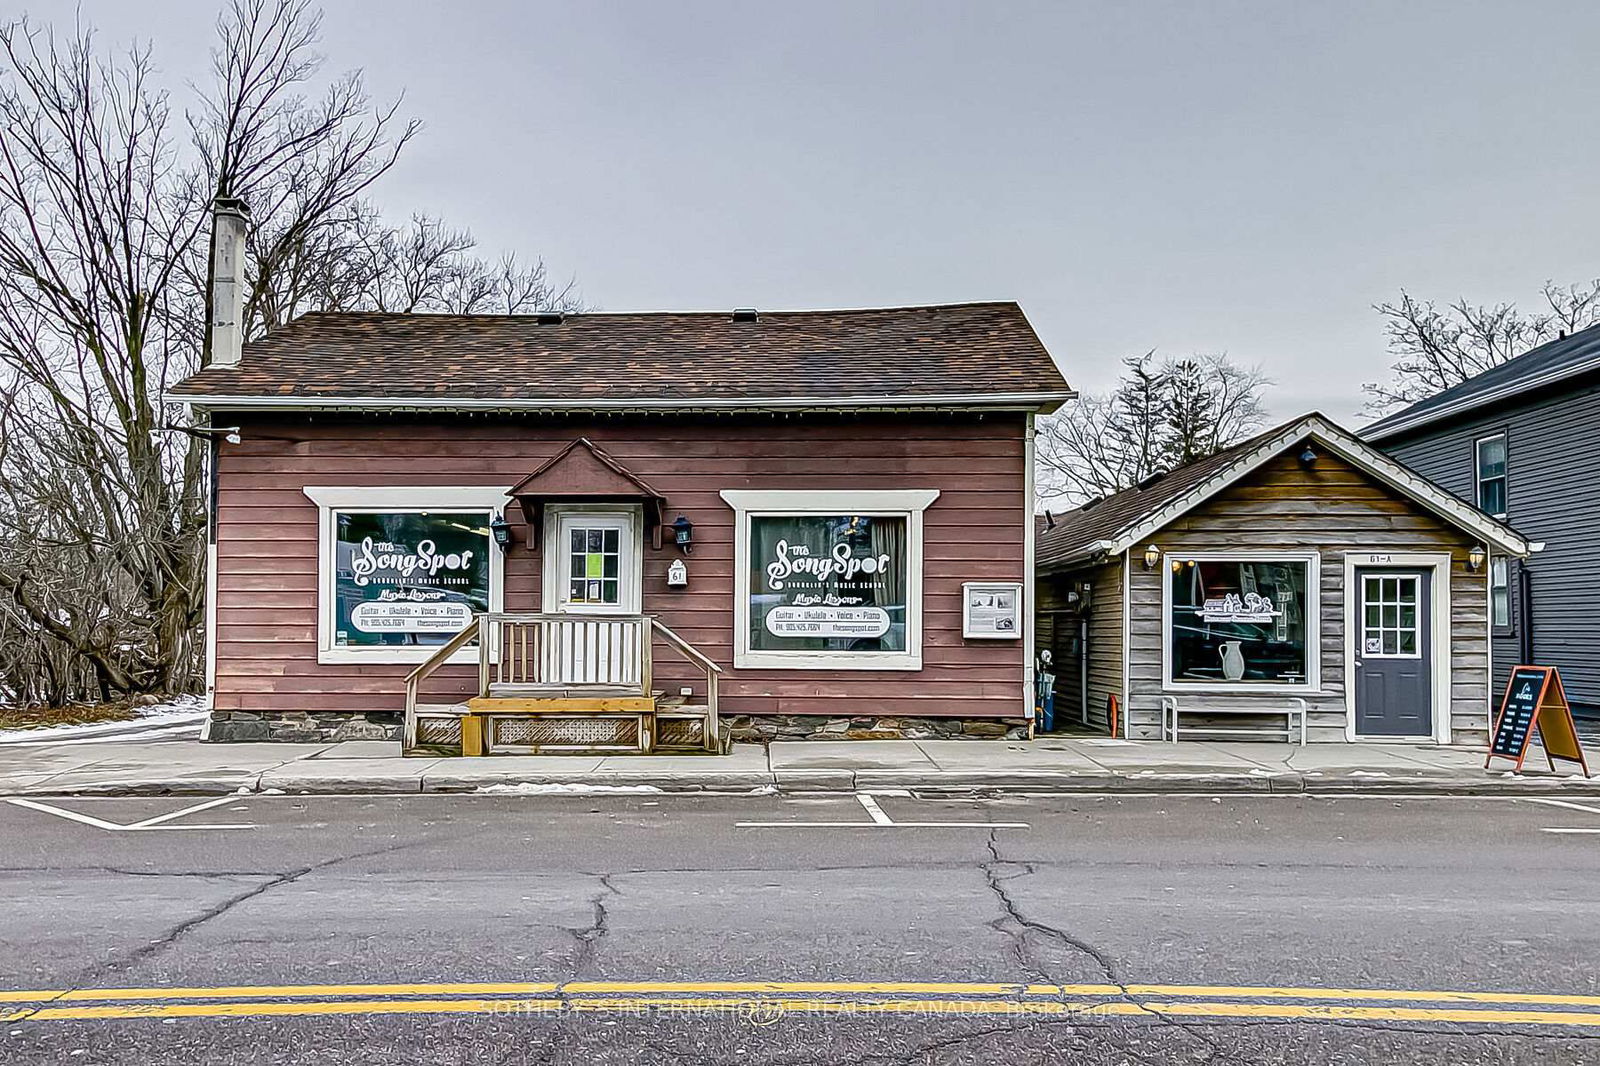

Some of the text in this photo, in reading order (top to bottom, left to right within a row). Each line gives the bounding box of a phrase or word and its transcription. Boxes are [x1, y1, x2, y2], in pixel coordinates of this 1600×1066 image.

[672, 571, 682, 581] 61
[776, 611, 794, 619] Guitar
[836, 611, 853, 620] Voice
[863, 611, 880, 620] Piano
